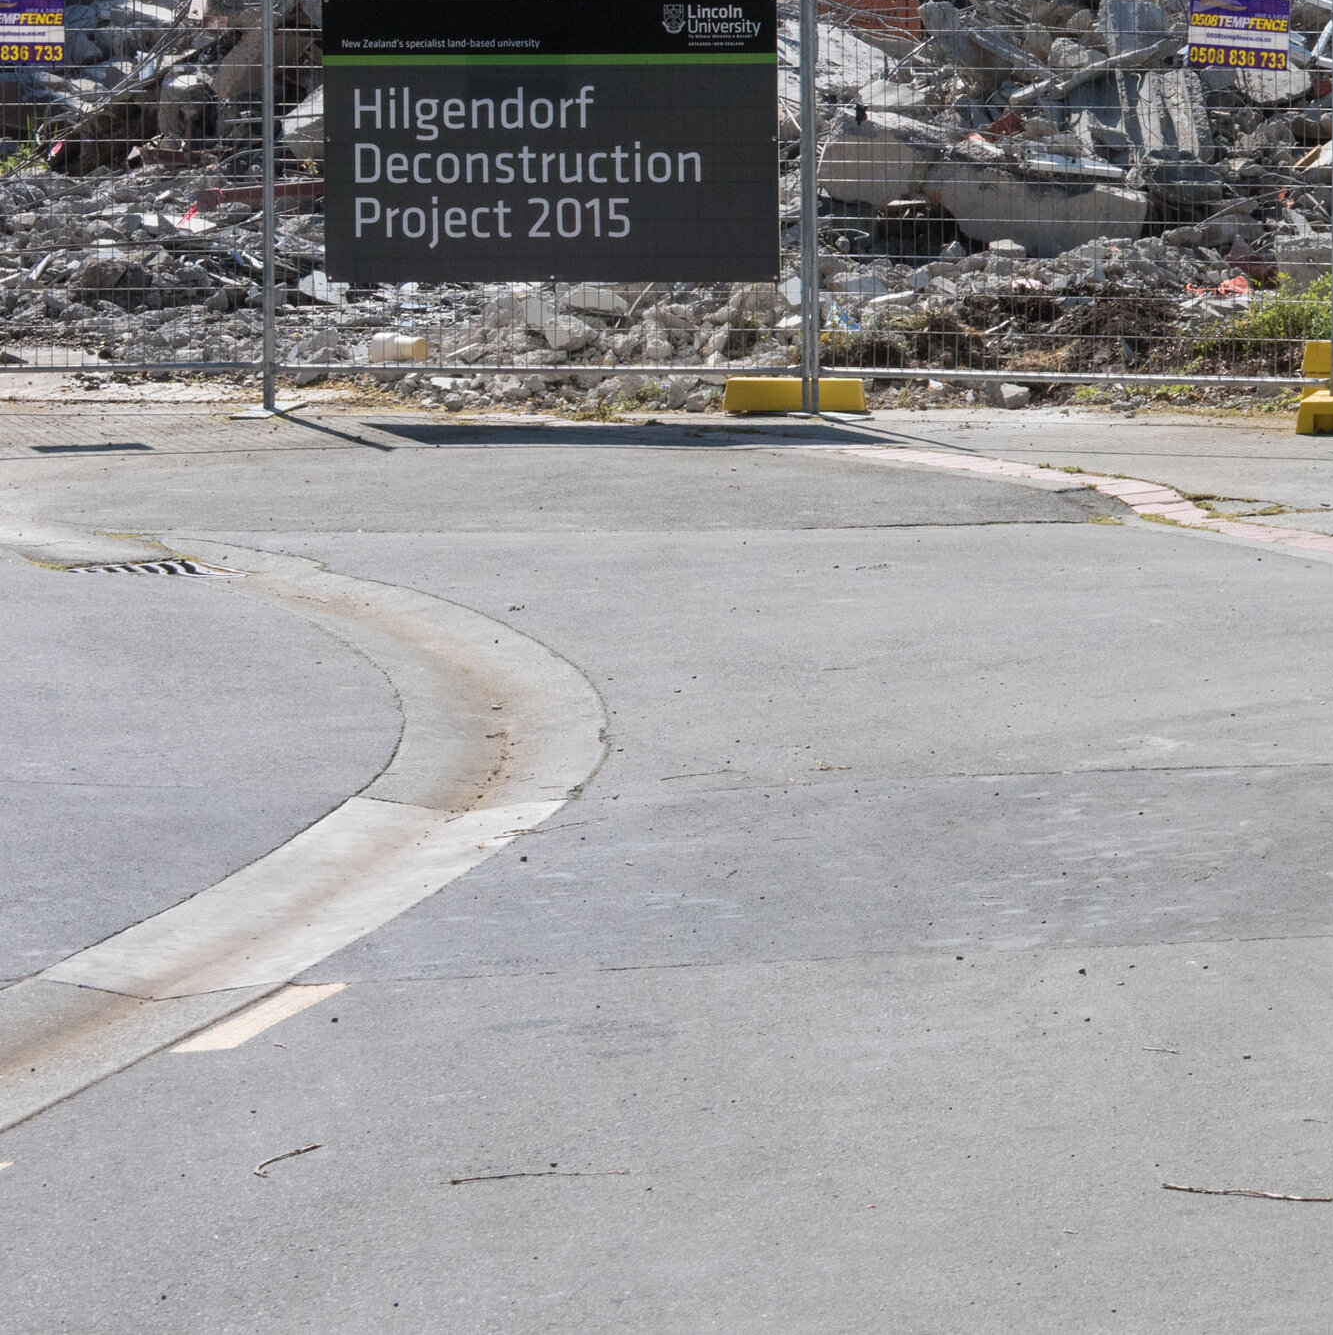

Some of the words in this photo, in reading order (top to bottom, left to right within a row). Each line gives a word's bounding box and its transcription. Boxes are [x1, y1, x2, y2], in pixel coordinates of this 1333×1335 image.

[687, 4, 743, 19] Lincoln
[687, 18, 761, 37] University
[1191, 13, 1288, 32] 0508TEMPFENCE
[1, 45, 29, 61] 836
[34, 45, 63, 61] 733
[341, 39, 361, 48] New
[363, 39, 404, 48] Zealand's
[405, 39, 445, 50] specialist
[447, 38, 496, 48] land-based
[497, 38, 541, 49] university
[1189, 46, 1225, 64] 0508
[1229, 49, 1256, 67] 836
[1260, 52, 1286, 69] 733
[354, 85, 595, 141] Hilgendorf
[354, 141, 702, 184] Deconstruction
[355, 196, 513, 249] Project
[527, 197, 631, 238] 2015
